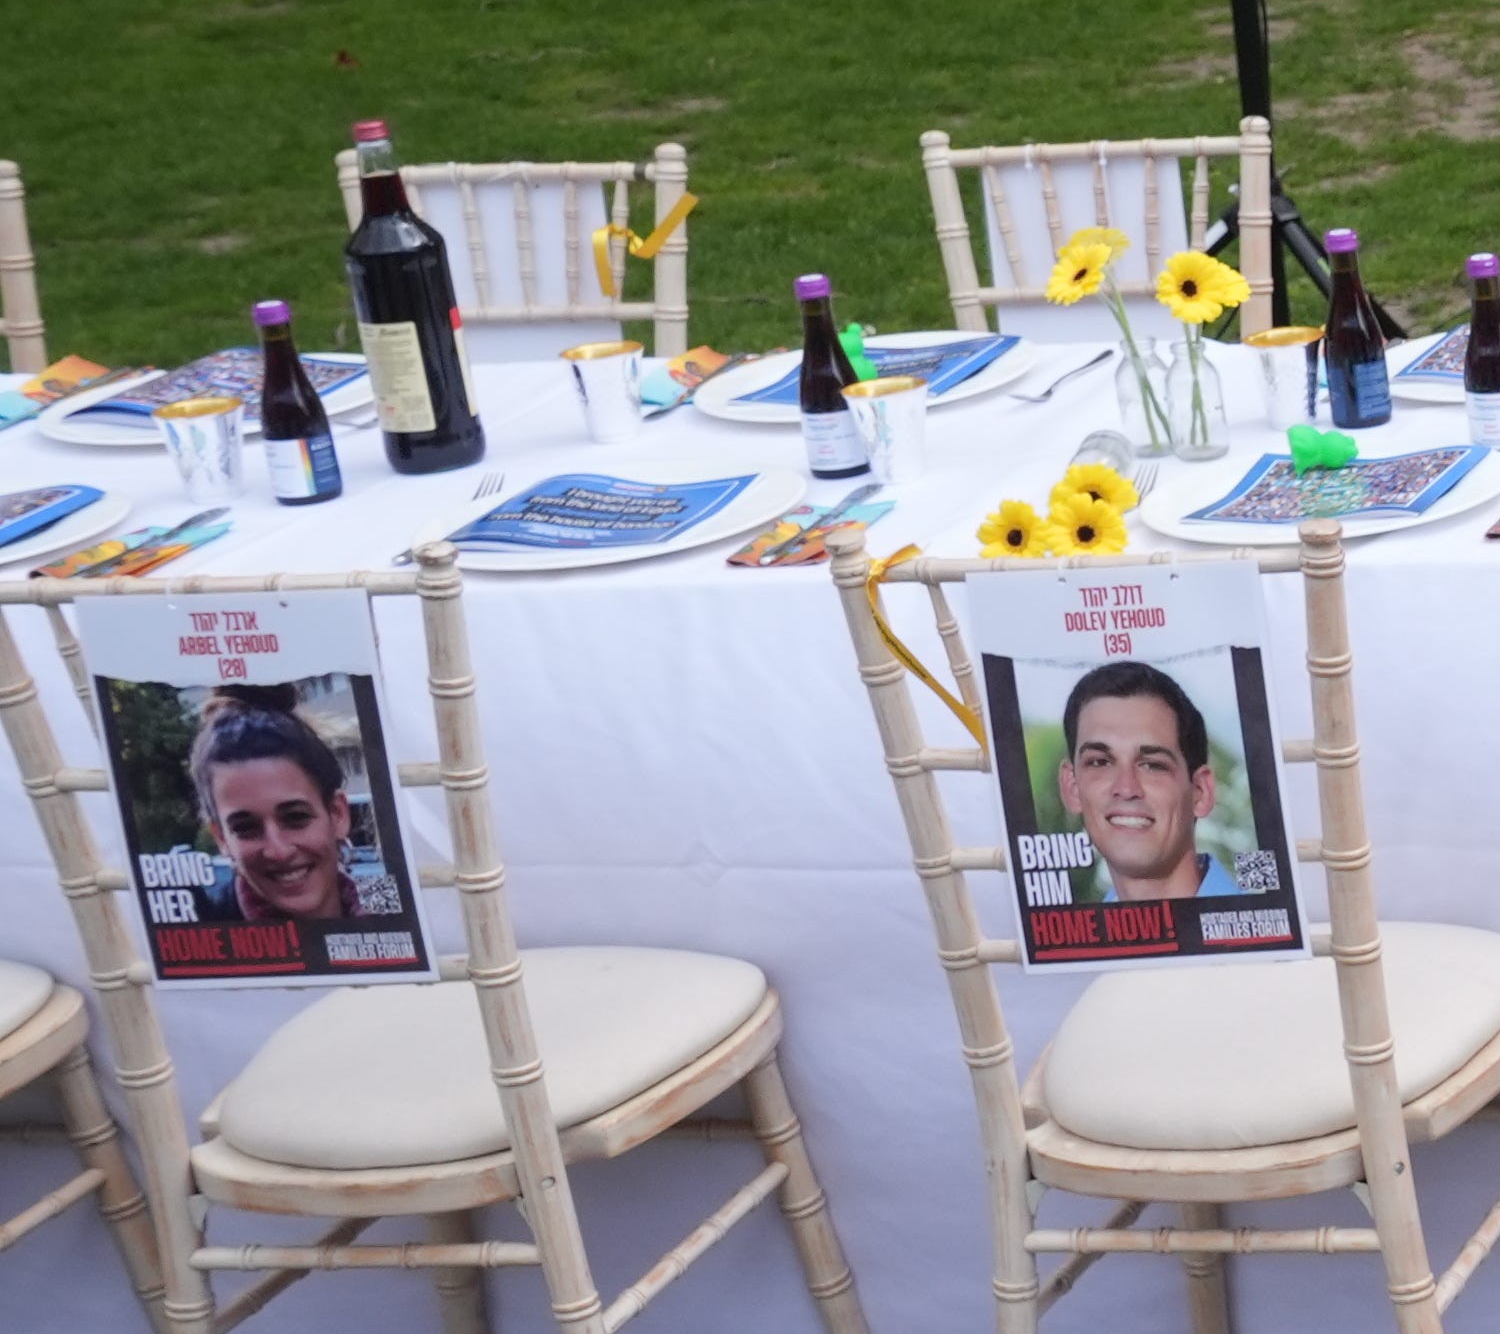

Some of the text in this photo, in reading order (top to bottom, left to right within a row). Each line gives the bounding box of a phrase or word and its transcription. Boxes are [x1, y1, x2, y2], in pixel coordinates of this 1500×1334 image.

[1078, 584, 1143, 608] דולב יהוד
[188, 611, 259, 632] ארבל יהוד
[1064, 607, 1166, 632] DOLEV YEHOUD
[179, 634, 279, 655] ARBEL YEHOUD
[1103, 632, 1132, 656] (35)
[218, 657, 247, 680] (28)
[1018, 831, 1094, 870] BRING
[139, 852, 215, 888] BRING
[1023, 870, 1072, 907] HIM
[147, 889, 199, 924] HER
[1030, 908, 1100, 946] HOME
[1202, 919, 1291, 941] FAMILIES FORUM
[156, 927, 227, 962] HOME
